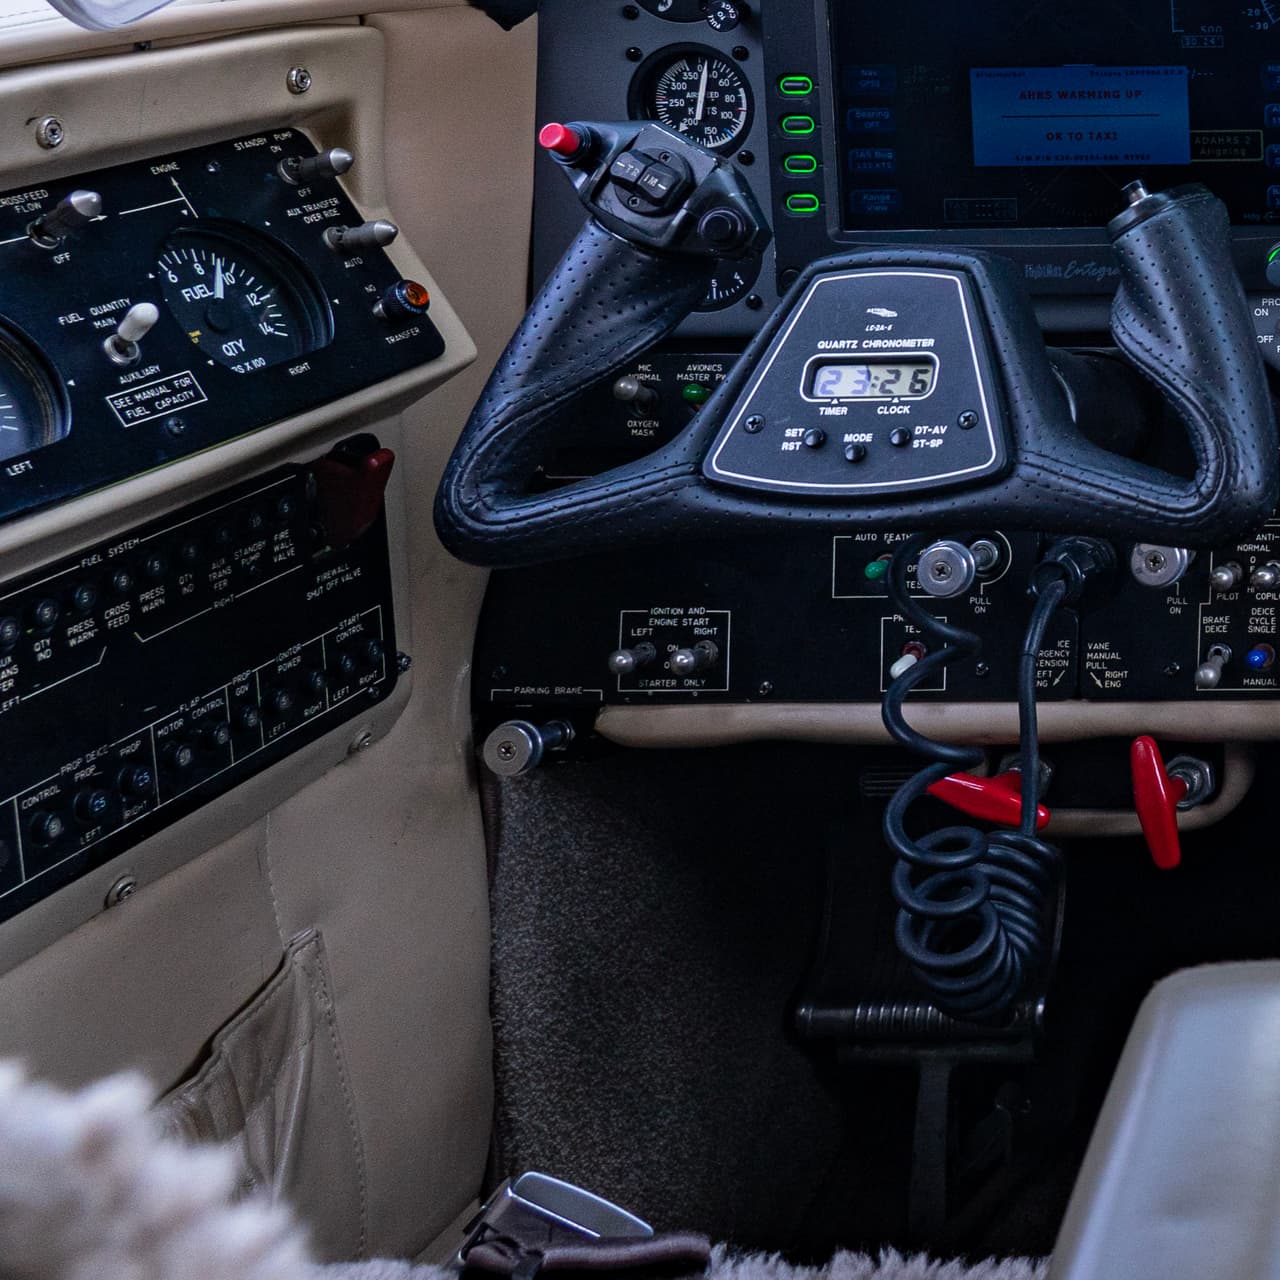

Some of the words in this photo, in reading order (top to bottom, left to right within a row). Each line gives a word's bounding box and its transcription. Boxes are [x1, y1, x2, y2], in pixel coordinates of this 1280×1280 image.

[150, 162, 181, 176] ENGINE
[181, 284, 215, 302] FUEL
[222, 339, 246, 358] QTY
[817, 340, 858, 349] QUARTZ
[862, 338, 935, 348] CHRONOMETER
[119, 365, 160, 384] AUXILIARY
[819, 369, 930, 395] 23:26
[113, 395, 132, 409] SEE
[134, 384, 171, 405] MANUAL
[174, 377, 193, 391] FOR
[126, 405, 150, 420] FUEL
[155, 389, 195, 413] CAPACITY
[877, 405, 911, 415] CLOCK
[819, 406, 848, 416] TIMER
[784, 428, 805, 437] SET
[914, 425, 948, 435] DT-AV
[843, 433, 873, 443] MODE
[913, 439, 943, 448] ST-SP
[781, 441, 802, 451] RST
